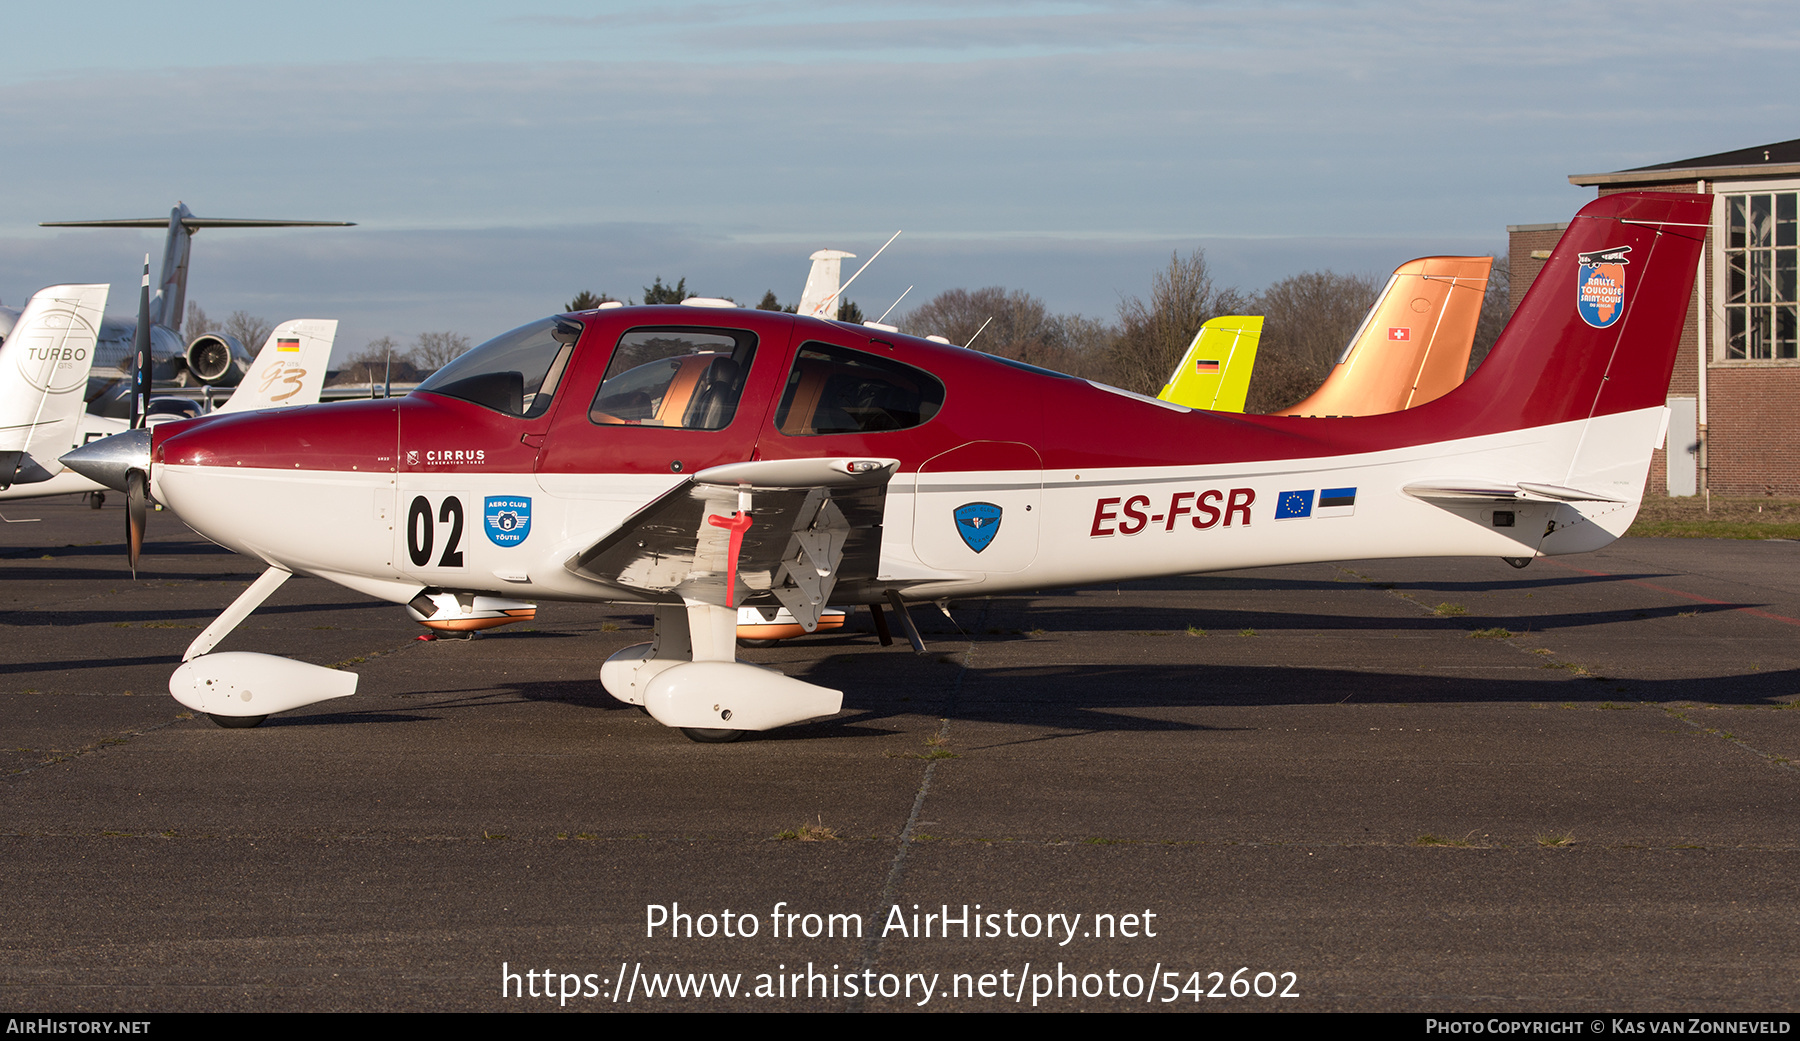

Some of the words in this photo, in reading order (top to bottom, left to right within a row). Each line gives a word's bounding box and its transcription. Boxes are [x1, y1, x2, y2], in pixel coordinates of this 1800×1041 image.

[1588, 278, 1615, 287] RALLYE
[1581, 286, 1621, 295] TOULOUSE
[1580, 294, 1622, 303] SAINT-LOUIS
[29, 348, 86, 361] TURBO
[426, 450, 485, 461] CIRRUS
[961, 507, 977, 515] AERO
[1090, 487, 1256, 538] ES-FSR
[408, 495, 463, 567] 02
[967, 534, 990, 543] MILANO
